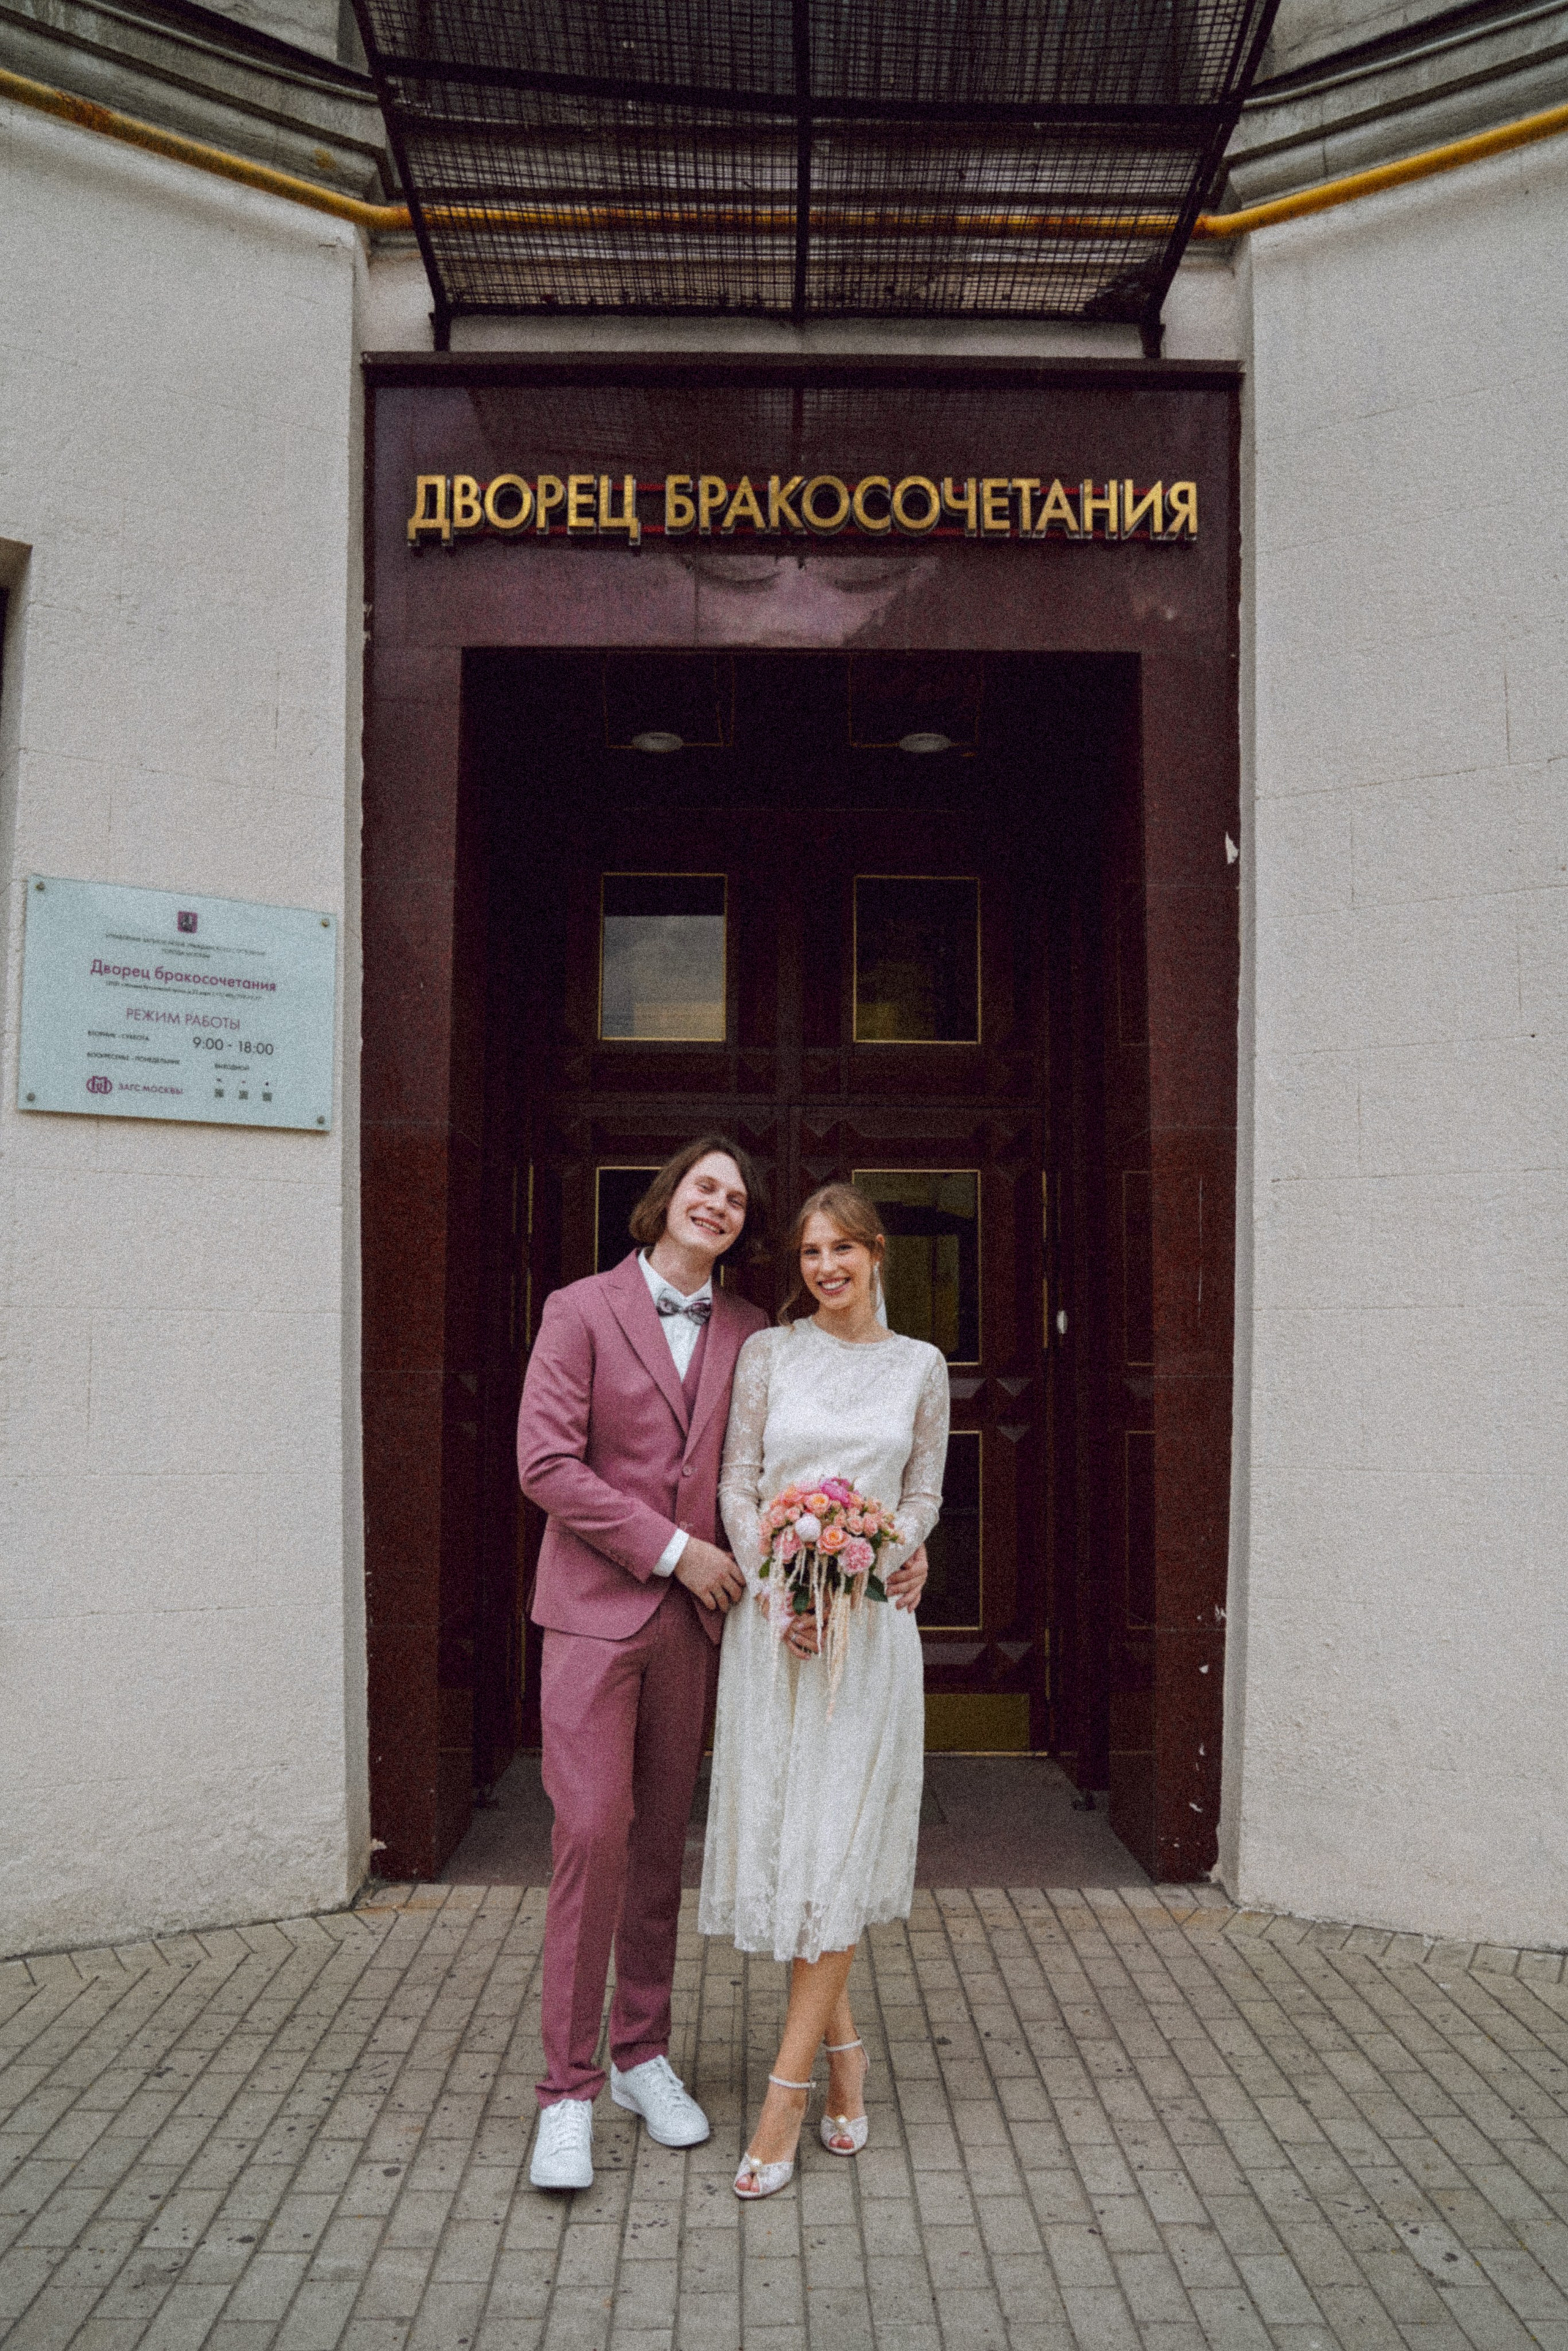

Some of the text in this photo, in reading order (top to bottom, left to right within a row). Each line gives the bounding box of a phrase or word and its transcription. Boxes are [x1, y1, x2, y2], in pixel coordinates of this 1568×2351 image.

[407, 474, 1199, 546] ДВОРЕЦ БРАКОСОЧЕТАНИЯ
[90, 959, 150, 980] Дворец
[154, 966, 276, 992] бракосочетания
[126, 1008, 241, 1031] РЕЖИМ РАБОТЫ
[193, 1036, 224, 1051] 9:00
[239, 1041, 274, 1055] 18:00
[119, 1082, 184, 1095] ЗАГС МОСКВЫ
